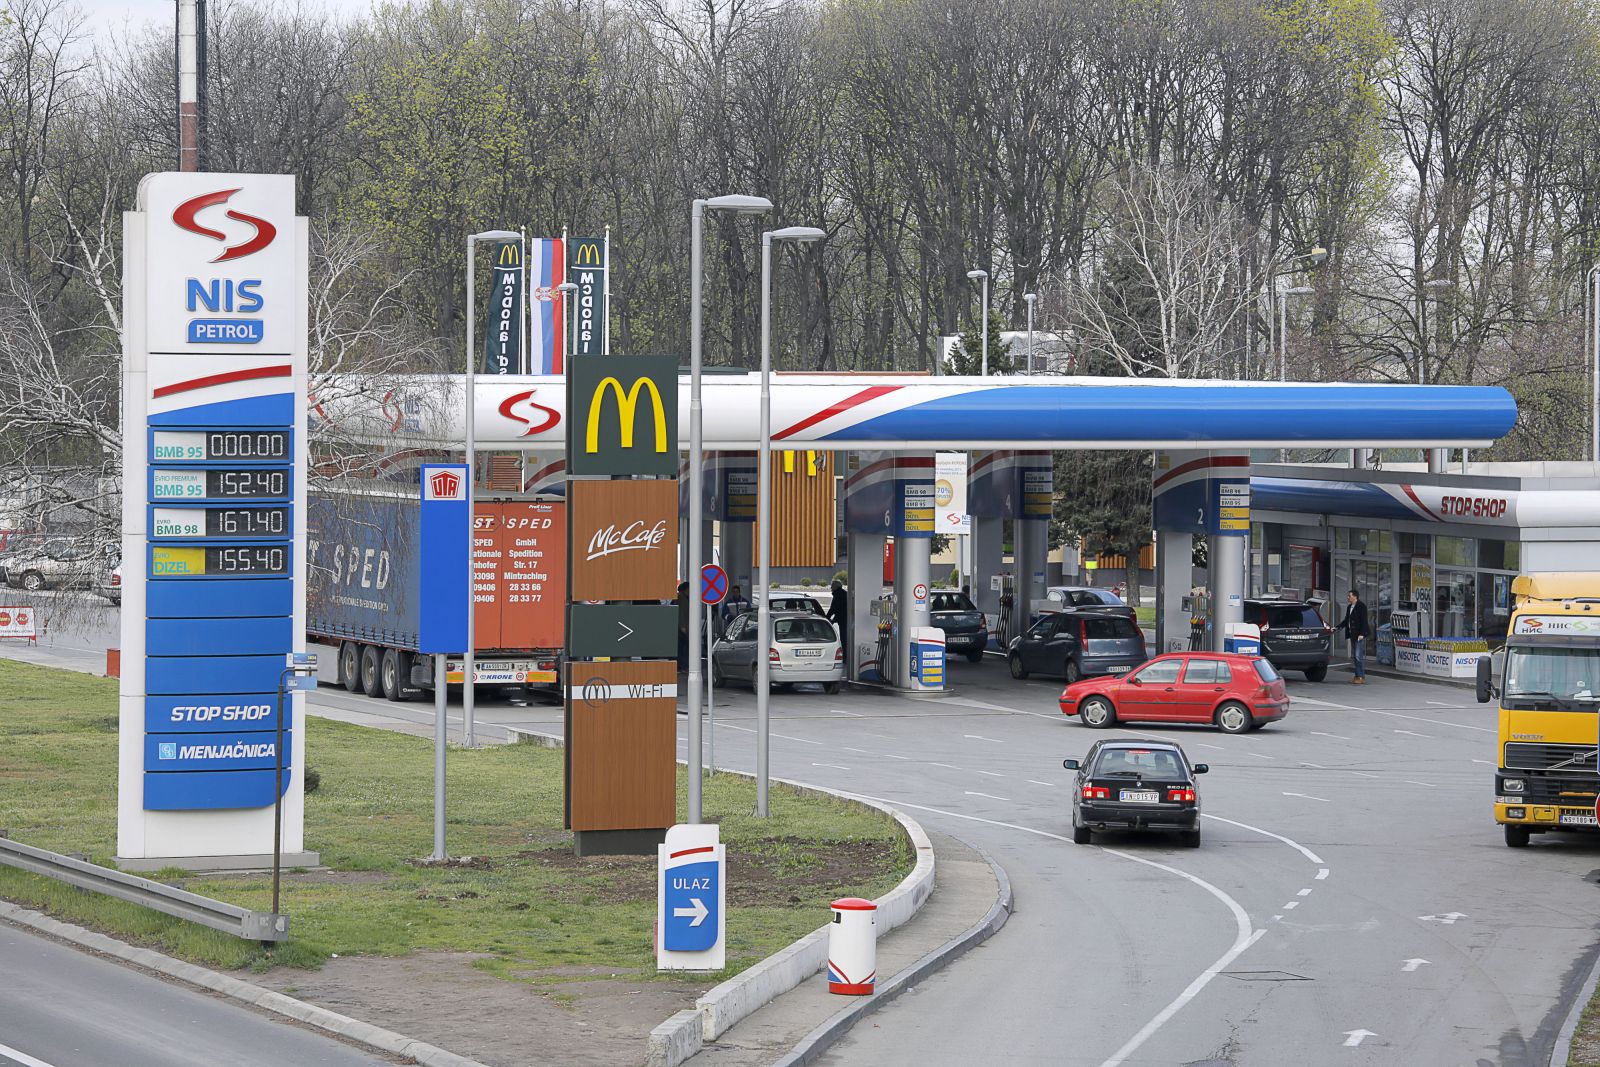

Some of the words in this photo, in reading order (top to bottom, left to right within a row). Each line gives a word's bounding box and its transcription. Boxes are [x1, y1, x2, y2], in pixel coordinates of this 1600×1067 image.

[186, 278, 264, 312] NIS
[196, 324, 257, 338] PETROL
[155, 447, 184, 458] BMB
[188, 447, 203, 458] 95
[211, 434, 283, 456] 000.00
[155, 485, 183, 496] BMB
[187, 485, 202, 496] 95
[220, 473, 283, 494] 152.40
[431, 472, 460, 497] UTA
[1441, 496, 1472, 515] STOP
[1473, 499, 1507, 518] SHOP
[157, 525, 181, 535] BMB
[184, 525, 198, 534] 98
[219, 511, 282, 532] 167.40
[474, 518, 494, 528] ST
[507, 518, 552, 528] SPED
[885, 510, 890, 526] 6
[1198, 508, 1203, 524] 2
[588, 520, 666, 556] McCafé
[154, 561, 190, 573] DIZEL
[219, 549, 282, 570] 155.40
[509, 550, 543, 558] Spedition
[332, 544, 389, 589] SPED
[504, 572, 547, 581] Mintraching
[1398, 650, 1420, 662] NISOTEC
[1426, 654, 1449, 665] NISOTEC
[628, 684, 663, 697] Wi-Fi
[171, 706, 221, 722] STOP
[222, 705, 271, 721] SHOP
[179, 741, 276, 759] MENJAČNICA
[673, 878, 710, 890] ULAZ
